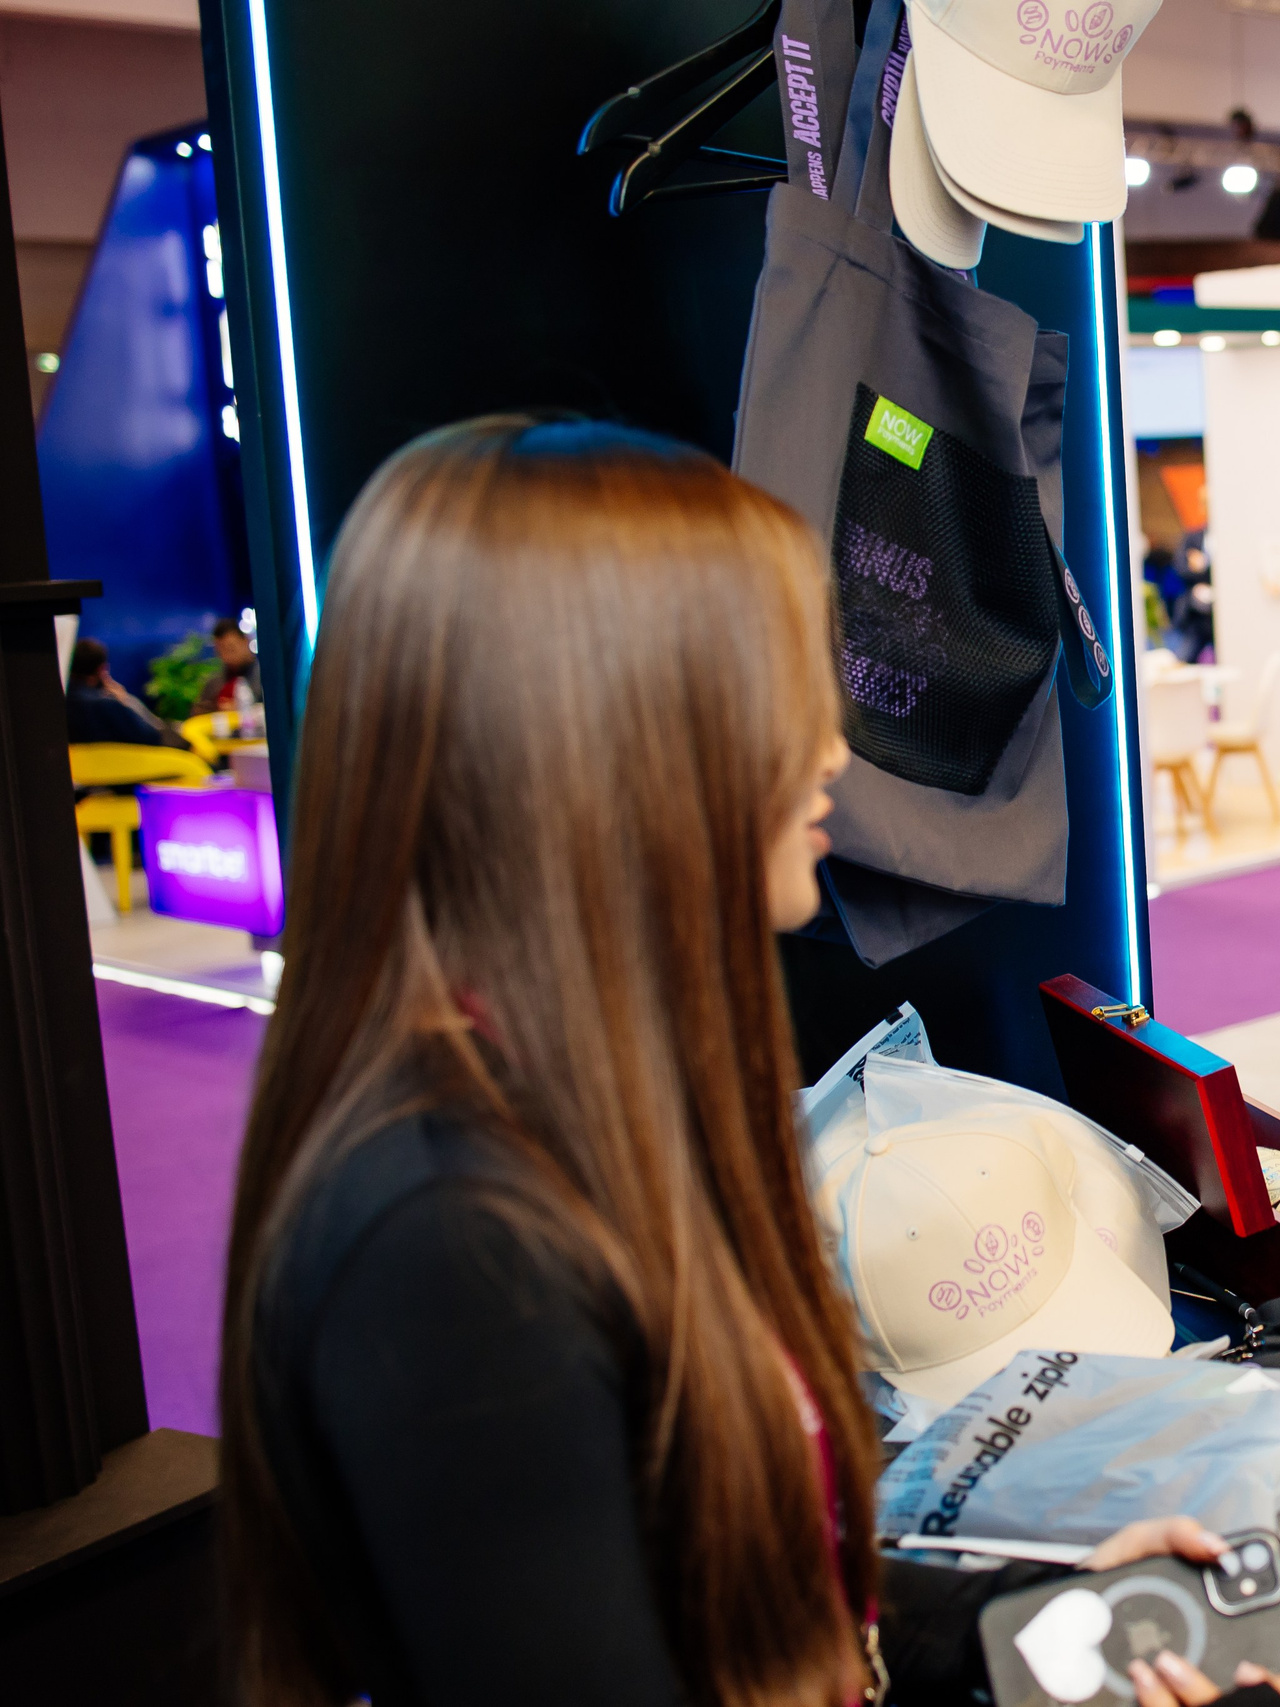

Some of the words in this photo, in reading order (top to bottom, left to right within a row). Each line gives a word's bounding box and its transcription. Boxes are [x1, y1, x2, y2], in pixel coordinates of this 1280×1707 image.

[782, 34, 812, 61] IT
[1034, 50, 1096, 74] Payments
[1040, 28, 1109, 62] NOW
[785, 60, 822, 149] ACCEPT
[807, 151, 829, 201] APPENS
[880, 409, 923, 446] NOW
[966, 1245, 1030, 1307] NOW
[978, 1267, 1039, 1318] Payments
[920, 1406, 1032, 1537] Reusable
